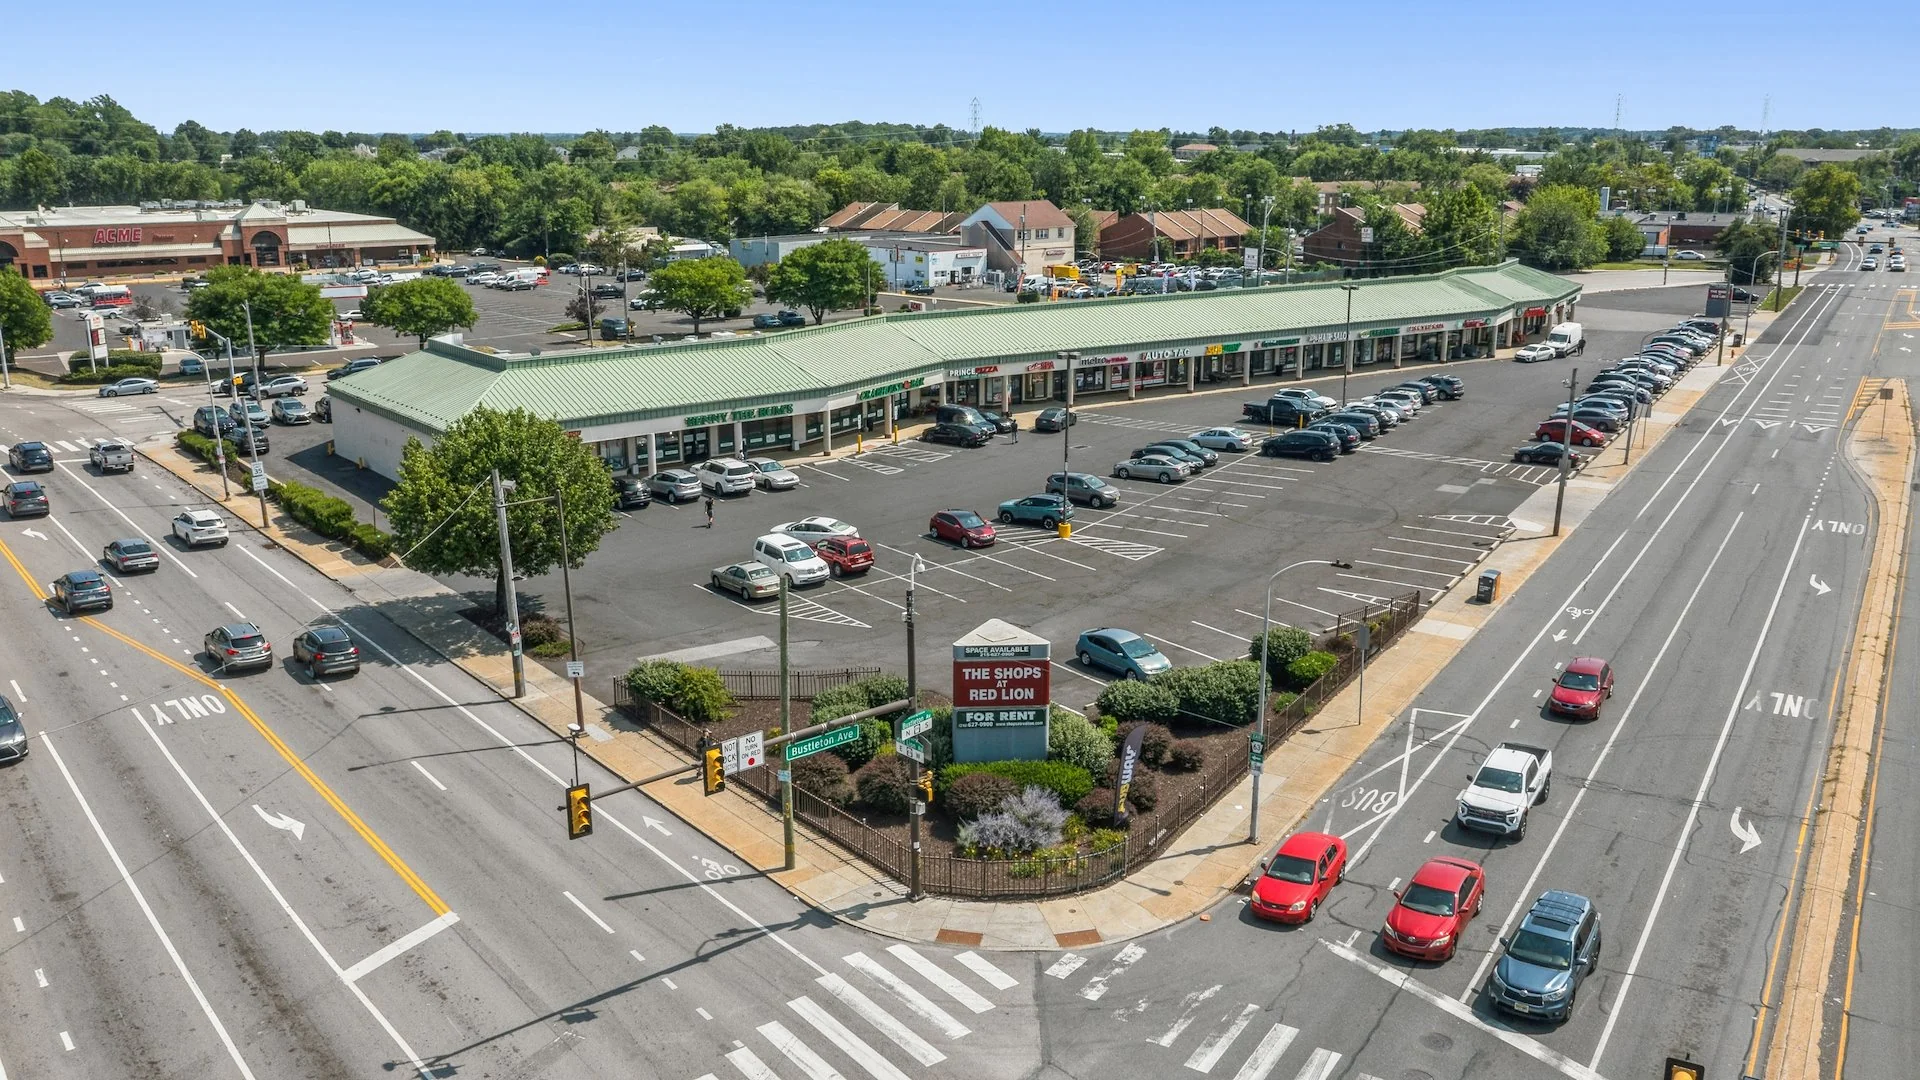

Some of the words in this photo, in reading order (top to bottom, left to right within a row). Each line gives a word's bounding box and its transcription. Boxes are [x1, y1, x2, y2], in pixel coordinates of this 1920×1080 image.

[94, 227, 142, 244] ACME
[1333, 330, 1352, 341] SALO
[1146, 350, 1170, 360] AUTO
[1172, 348, 1190, 358] TAG
[1081, 355, 1107, 366] metro
[949, 367, 976, 377] PRINCE
[975, 365, 998, 375] PIZZA
[731, 408, 756, 421] THE
[1811, 519, 1865, 535] ONLY
[963, 668, 990, 680] THE
[994, 667, 1041, 679] SHOPS
[969, 689, 997, 701] RED
[1002, 688, 1034, 700] LION
[150, 694, 226, 726] ONLY
[1744, 690, 1818, 720] ONLY
[966, 712, 995, 722] FOR
[1000, 711, 1036, 720] RENT
[924, 721, 929, 729] S
[745, 736, 756, 744] NO
[791, 736, 834, 757] Bustleton
[837, 730, 854, 742] Ave
[724, 742, 736, 753] NOT
[745, 743, 758, 751] TURN
[750, 749, 761, 757] RED
[723, 753, 737, 764] OCK
[1117, 744, 1137, 813] SUBWAY
[1341, 786, 1397, 814] BUS
